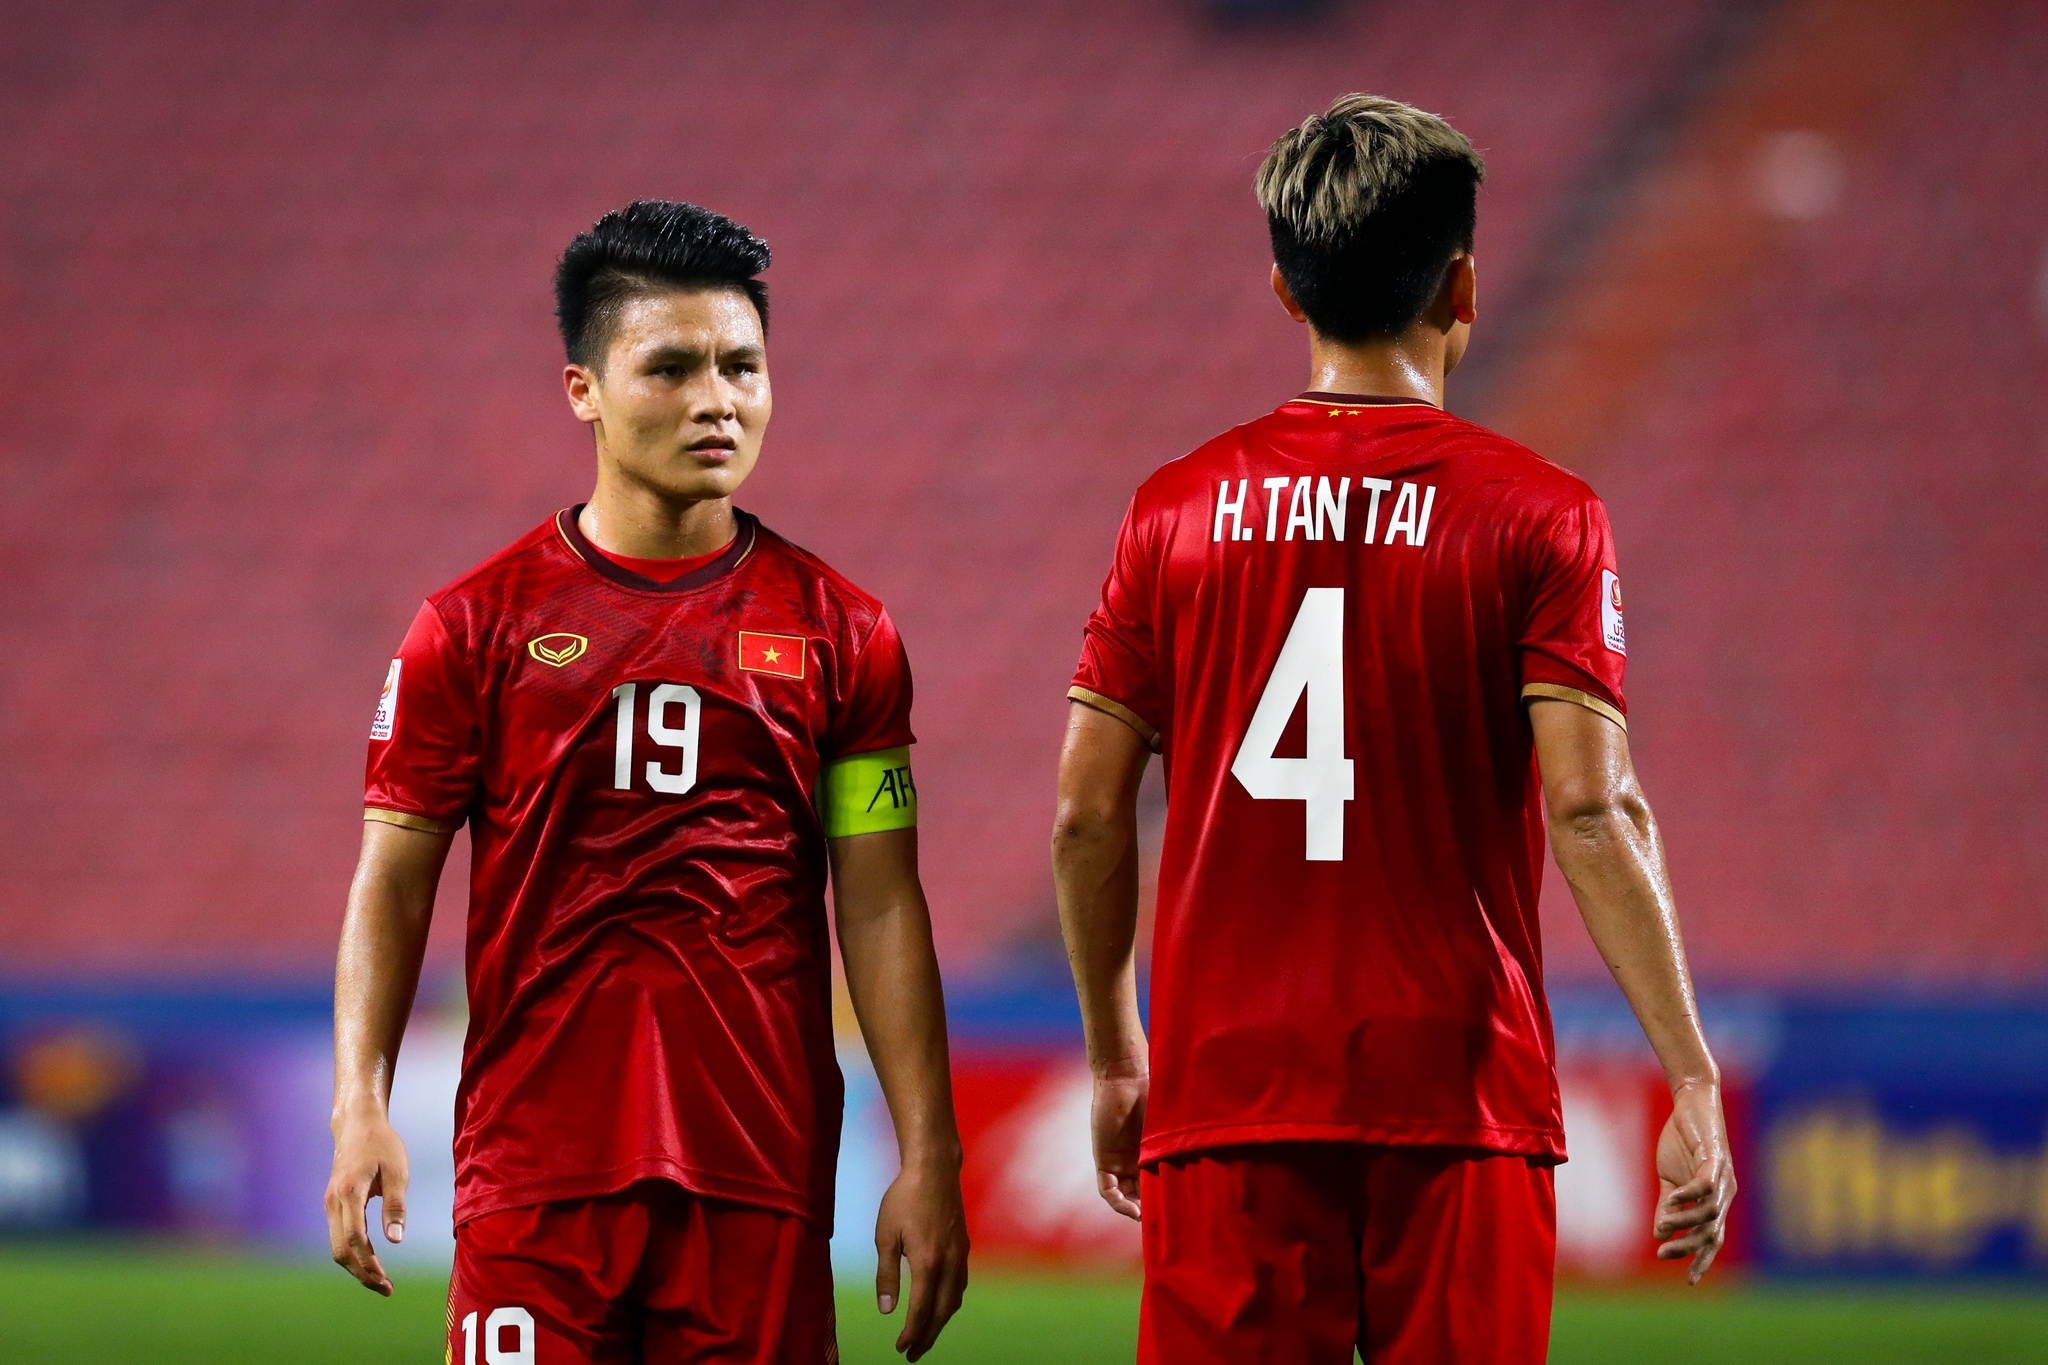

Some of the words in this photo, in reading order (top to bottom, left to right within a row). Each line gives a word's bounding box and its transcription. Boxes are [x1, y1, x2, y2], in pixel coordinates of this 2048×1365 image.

[1362, 476, 1437, 547] TAI
[612, 683, 701, 795] 19
[1230, 587, 1355, 861] 4
[461, 1303, 535, 1365] 19
